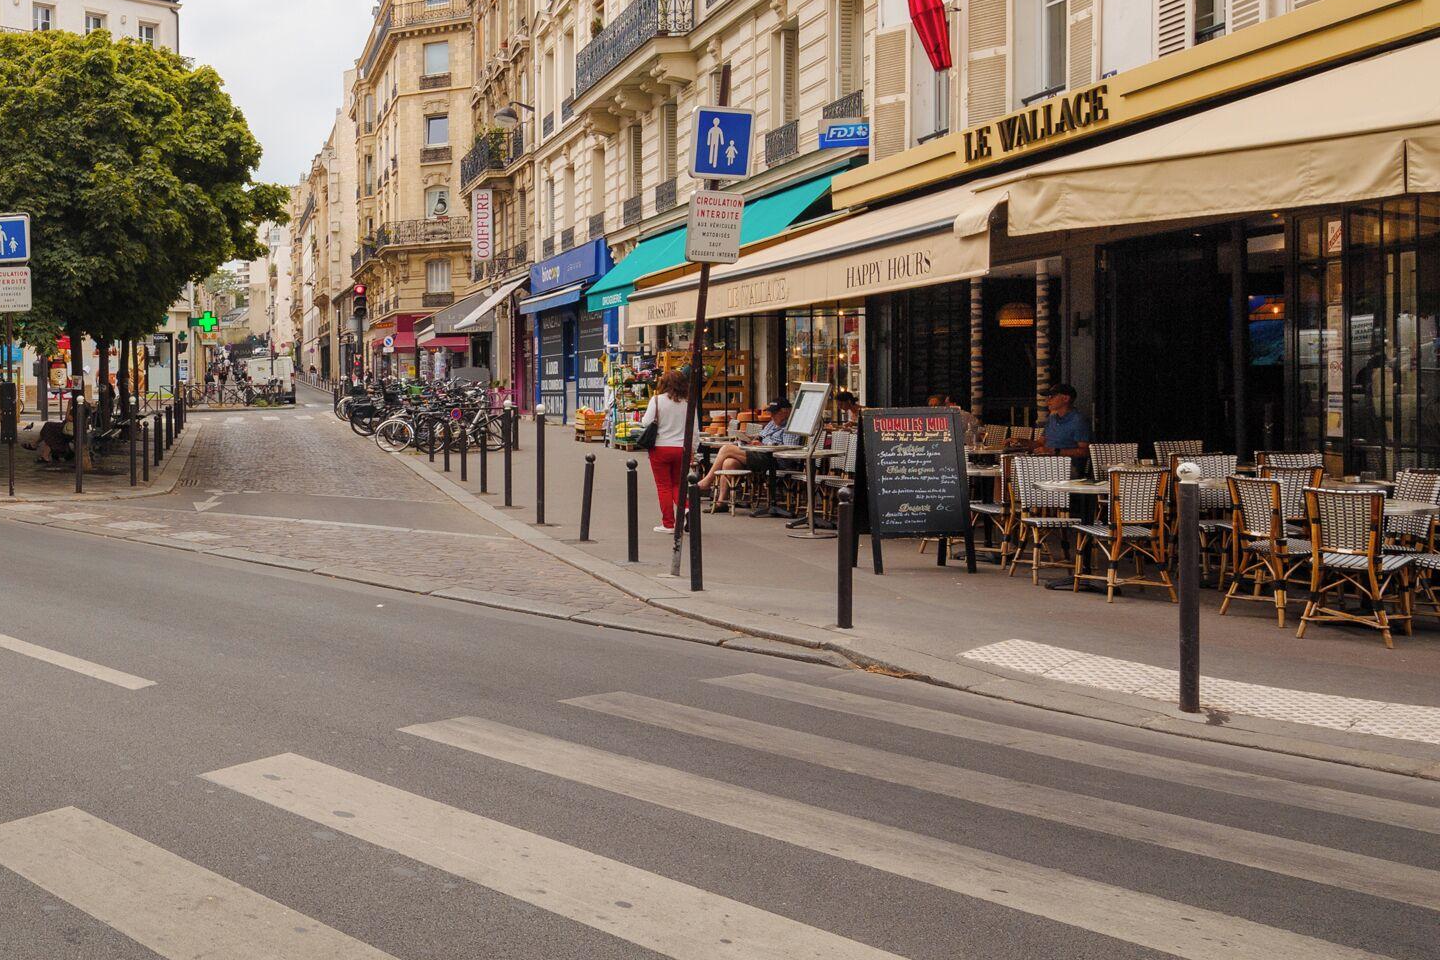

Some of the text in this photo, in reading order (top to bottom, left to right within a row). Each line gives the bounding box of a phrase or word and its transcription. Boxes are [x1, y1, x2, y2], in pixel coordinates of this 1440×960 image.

[829, 126, 855, 138] FDJ
[963, 84, 1109, 163] LE WALLACE
[696, 196, 743, 208] CIRCULATION
[696, 209, 740, 220] INTERDITE
[476, 192, 490, 258] COIFFURE
[716, 251, 737, 259] INTERNE
[846, 249, 932, 288] HAPPY HOURS
[727, 277, 788, 309] LE WALLACE
[647, 300, 678, 320] BRASSERIE
[873, 416, 949, 432] FORMULES MIDI
